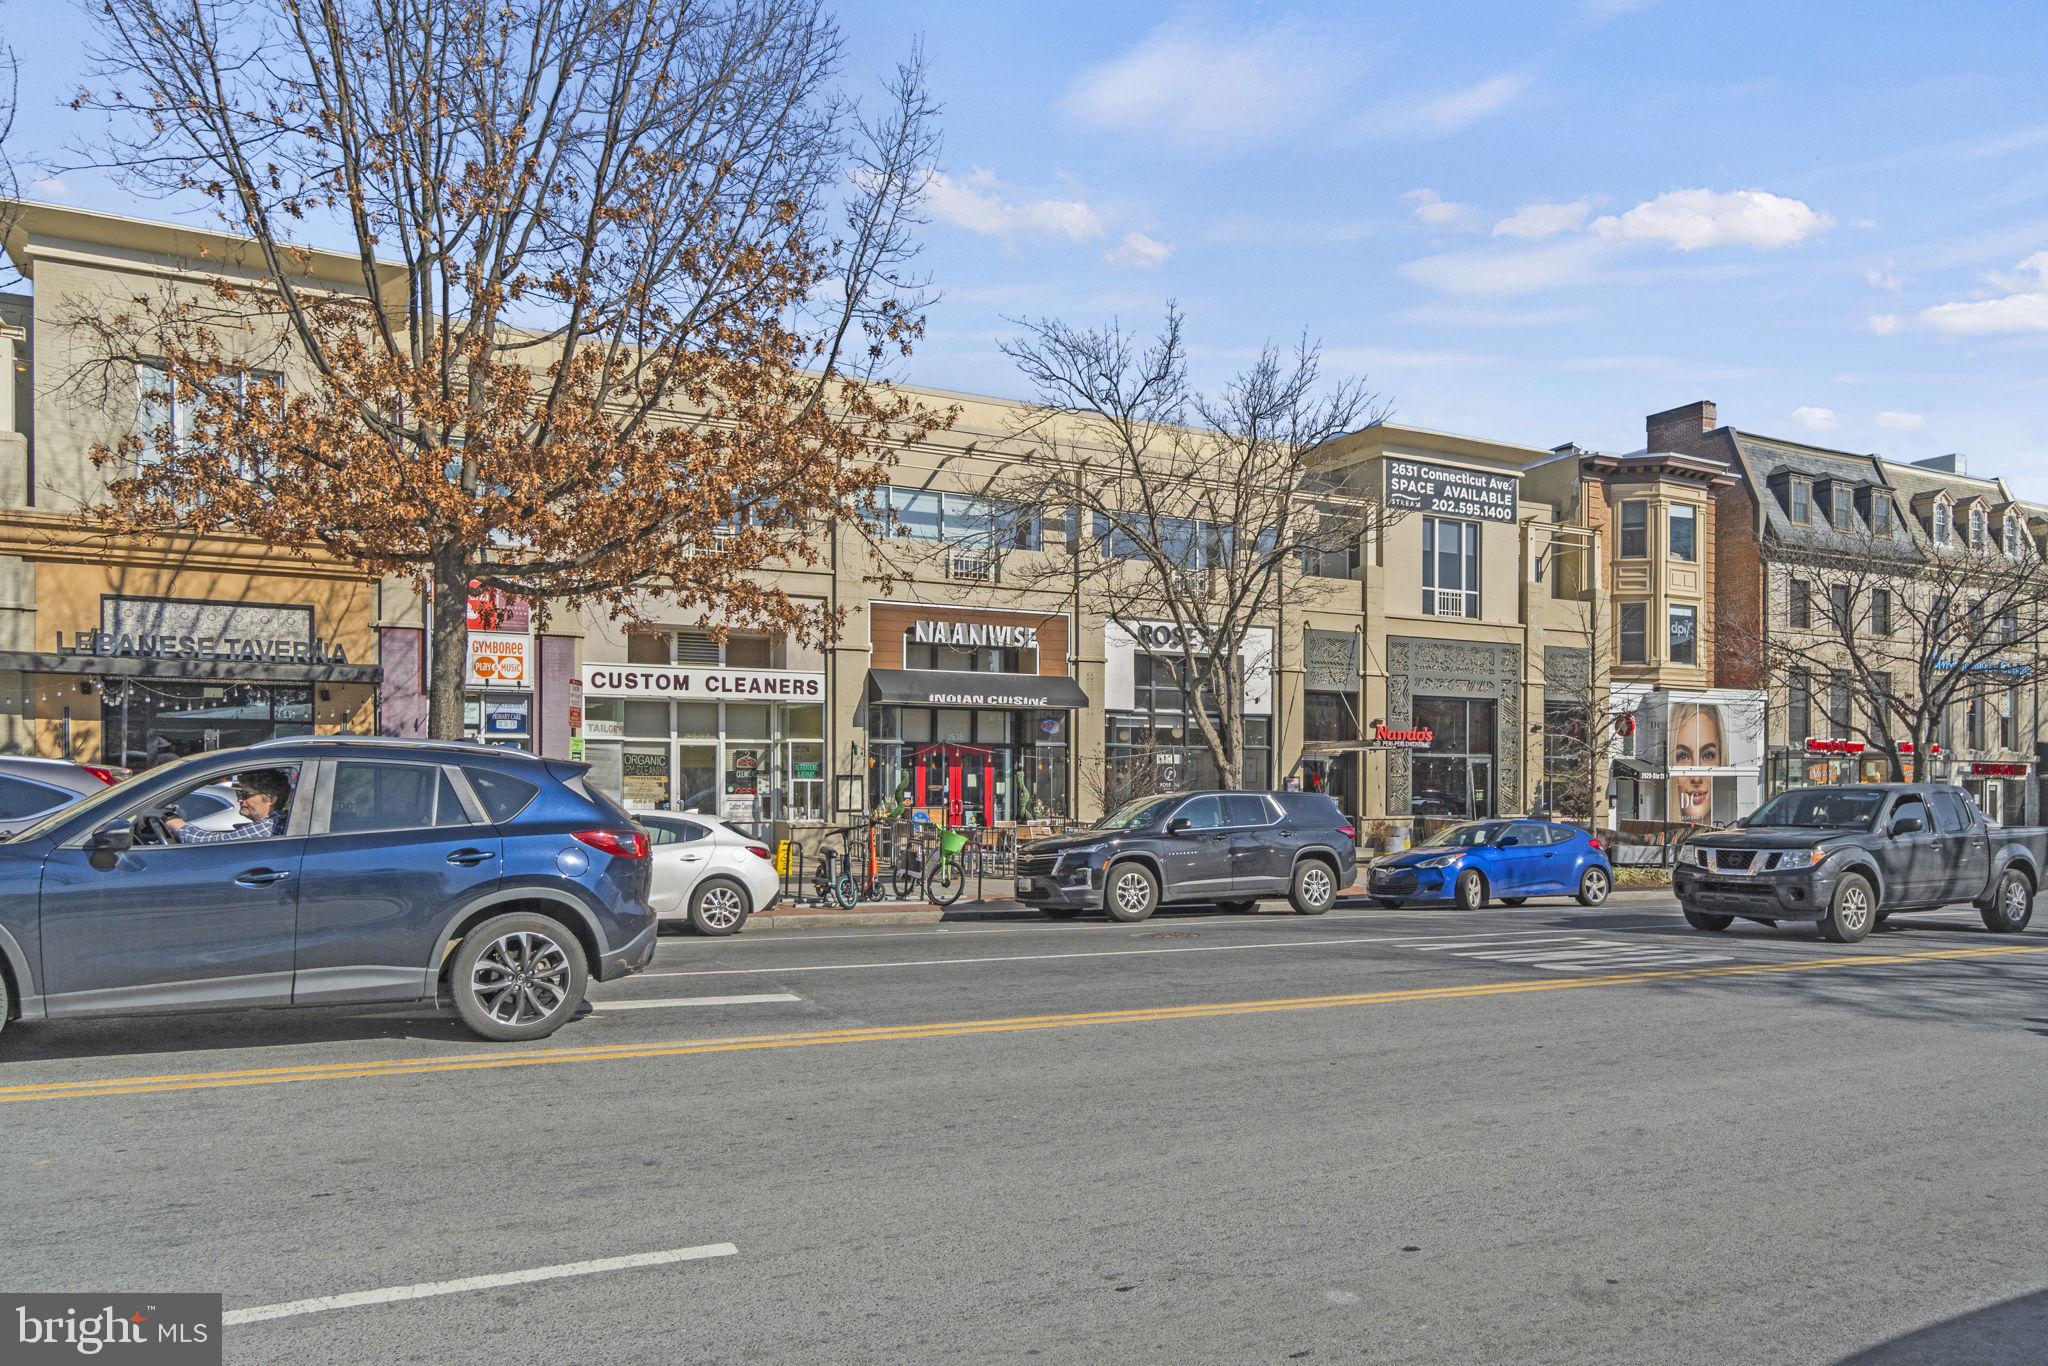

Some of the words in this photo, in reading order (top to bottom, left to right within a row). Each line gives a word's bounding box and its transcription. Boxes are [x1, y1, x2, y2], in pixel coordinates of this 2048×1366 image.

[1391, 462, 1418, 478] 2631
[1421, 467, 1487, 488] Connecticut
[1391, 477, 1435, 495] SPACE
[1443, 485, 1512, 506] AVAILABLE
[1431, 498, 1512, 520] 202.595.1400
[56, 630, 214, 660] LEBANESE
[224, 637, 349, 664] TAVERNA
[915, 620, 1037, 649] NAANWISE
[591, 671, 690, 691] CUSTOM
[705, 675, 819, 696] CLEANERS
[987, 695, 1048, 706] CUISINE
[1375, 724, 1433, 742] Nando's
[624, 754, 666, 767] ORGANIC
